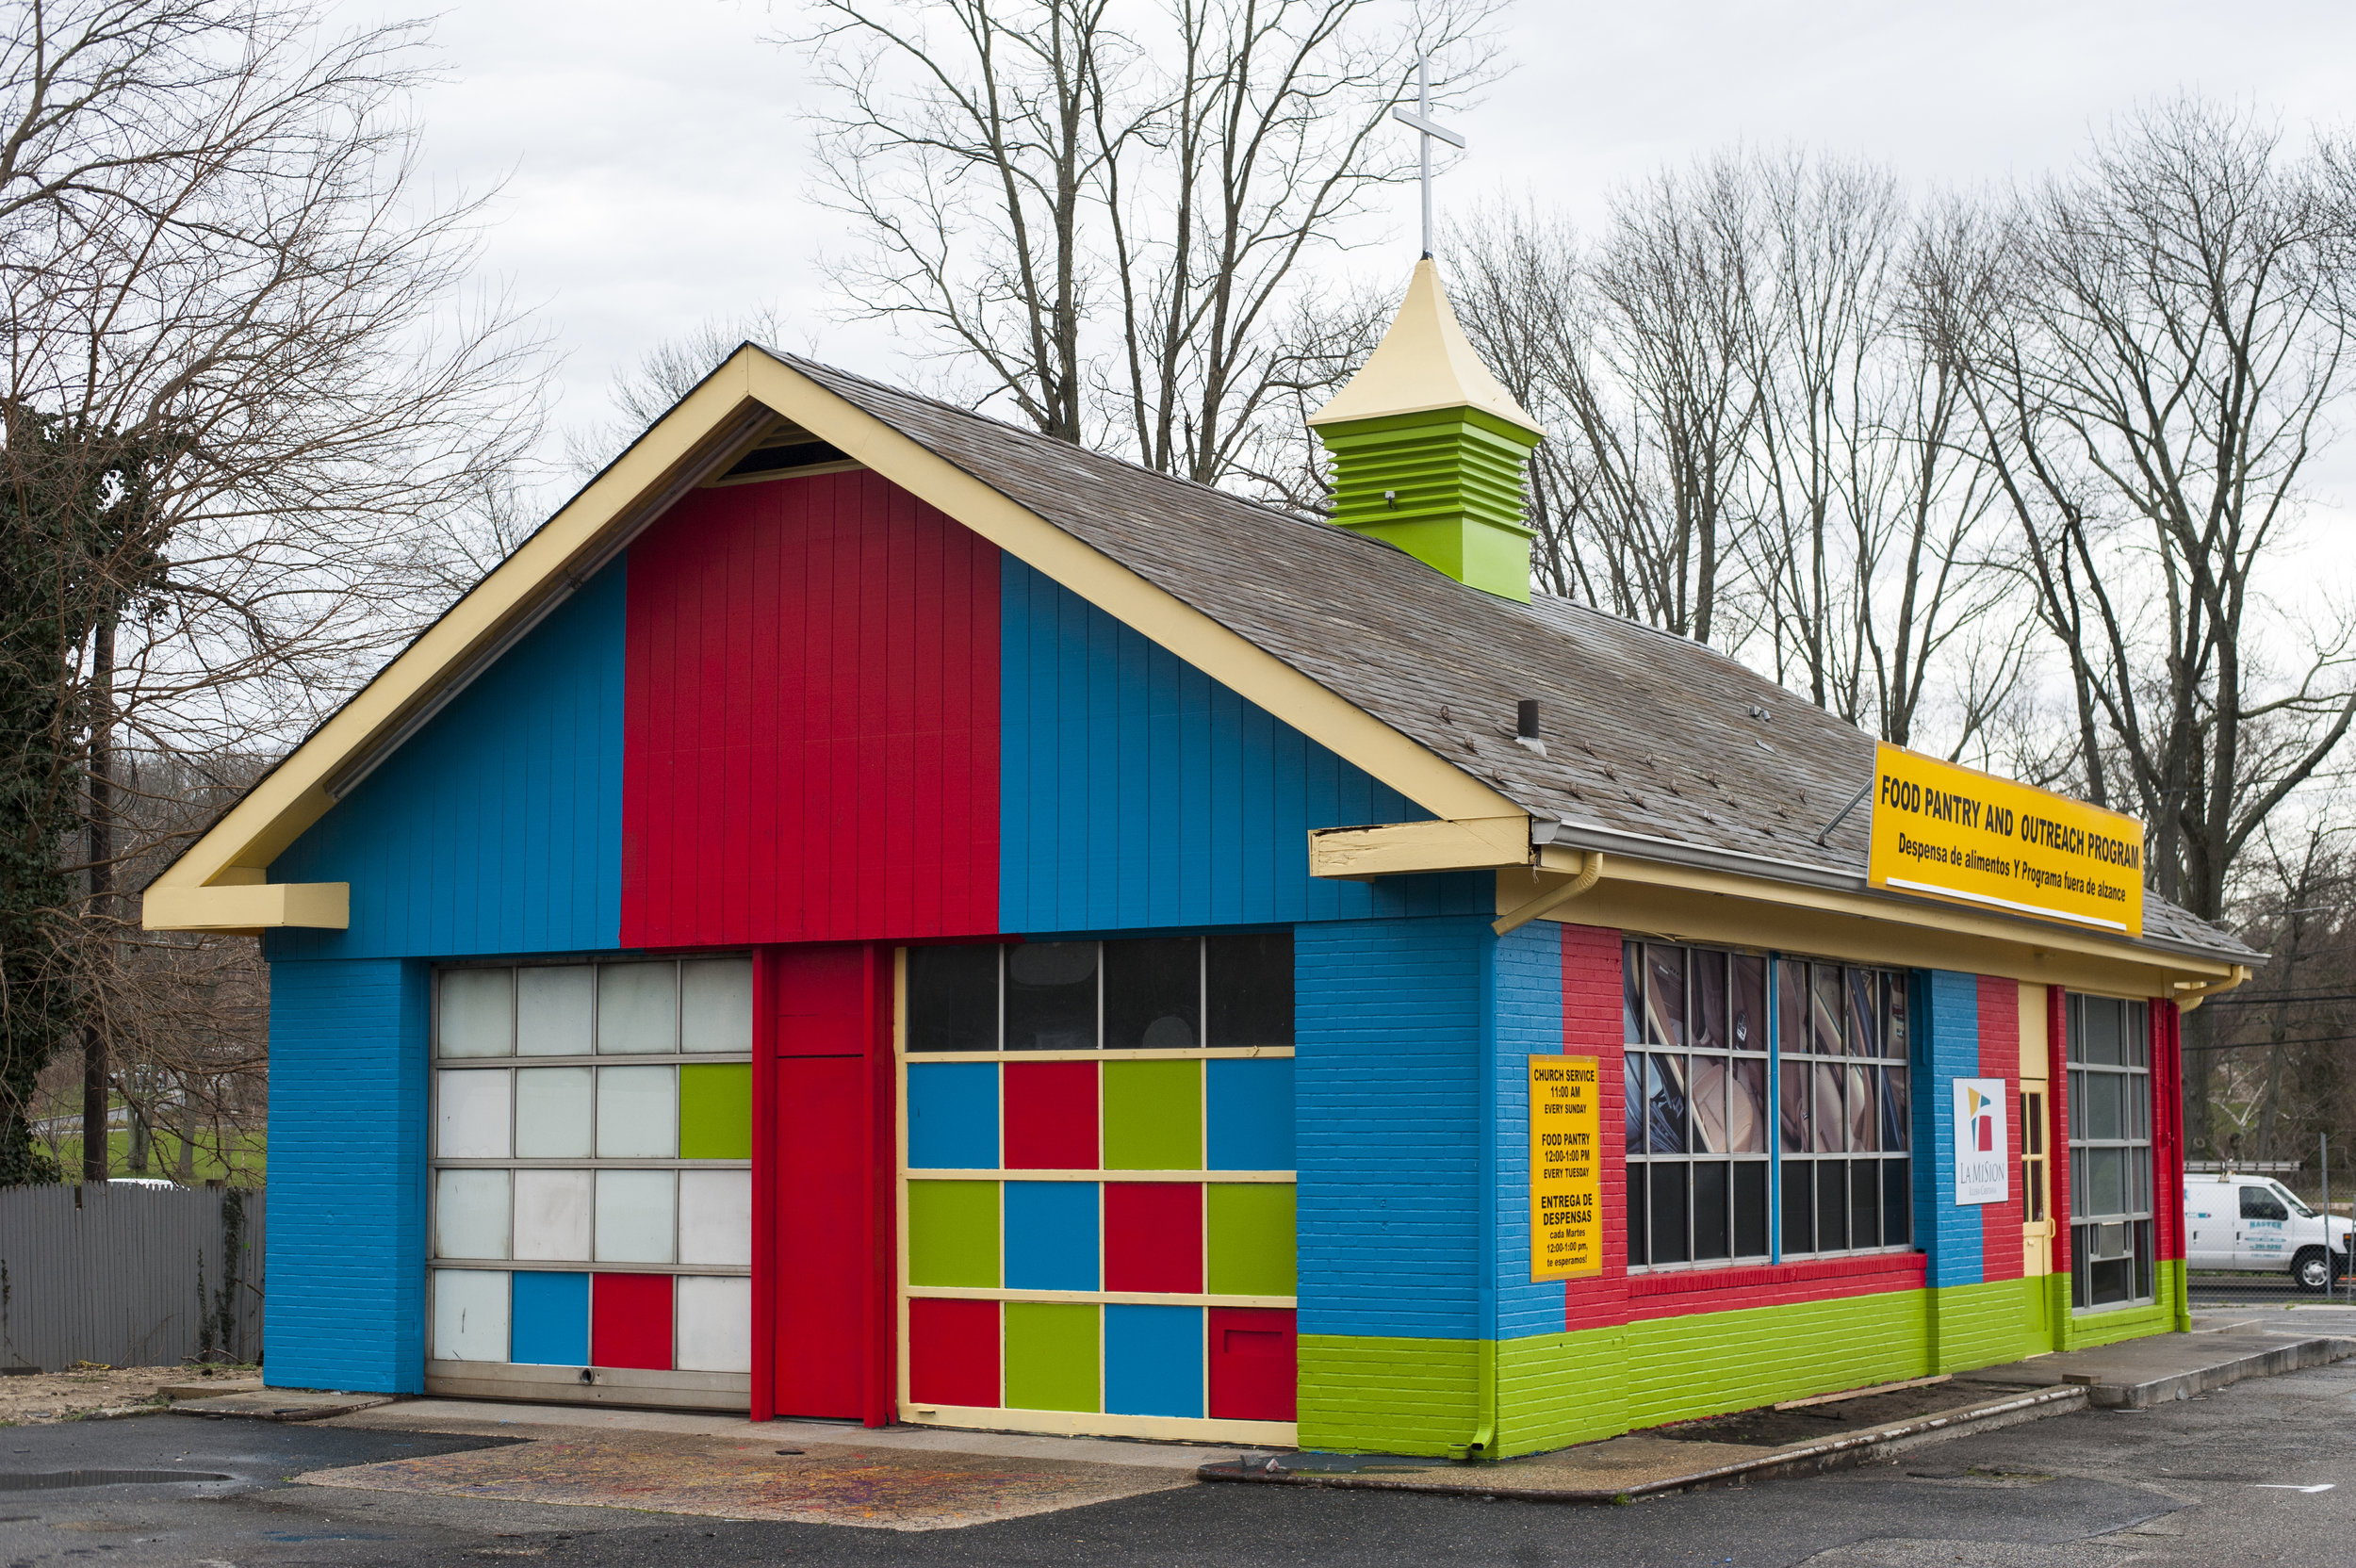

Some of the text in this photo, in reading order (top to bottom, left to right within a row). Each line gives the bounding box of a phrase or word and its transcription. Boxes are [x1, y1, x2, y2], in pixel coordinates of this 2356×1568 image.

[1881, 776, 2139, 870] FOOD PANTRY AND OUTREACH PROGRAM
[1898, 833, 2126, 902] Despensa de alimentos Y Programa fuera de alzance
[1534, 1070, 1595, 1082] CHURCH SERVICE
[1551, 1086, 1580, 1098] 11:00 AM
[1545, 1104, 1587, 1114] EVERY SUNDAY
[1542, 1134, 1590, 1146] FOOD PANTRY
[1546, 1150, 1590, 1162] 12:00-1:00 PM
[1544, 1168, 1590, 1179] EVERY TUESDAY
[1542, 1194, 1593, 1209] ENTREGA DE
[1544, 1210, 1592, 1226] DESPENSAS
[1550, 1228, 1585, 1239] cada Martes
[1546, 1242, 1577, 1252] 12:00-1:00
[1547, 1255, 1587, 1267] te esperamos!
